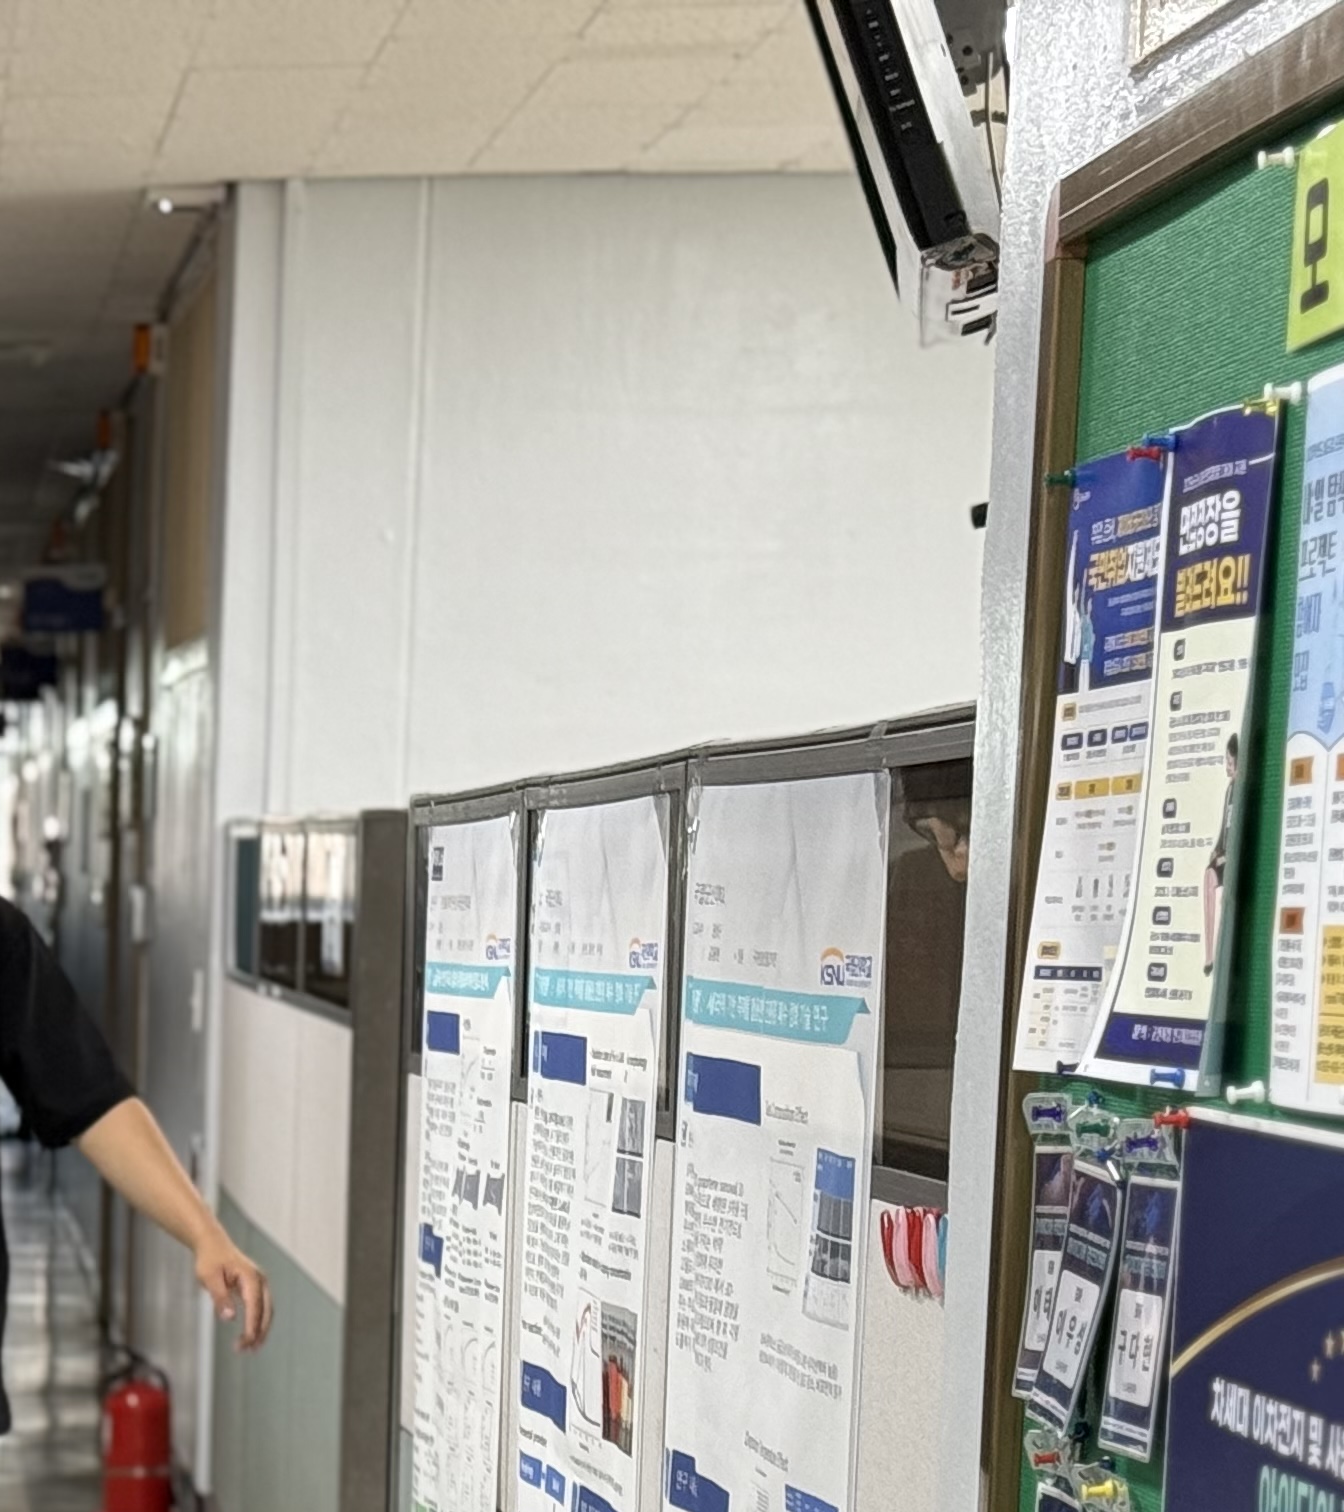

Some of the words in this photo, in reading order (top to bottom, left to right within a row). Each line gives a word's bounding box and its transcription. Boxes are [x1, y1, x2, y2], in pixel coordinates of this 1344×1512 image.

[1210, 1377, 1250, 1438] 차세대
[1253, 1394, 1305, 1462] 이차전지
[1308, 1415, 1324, 1470] 및
